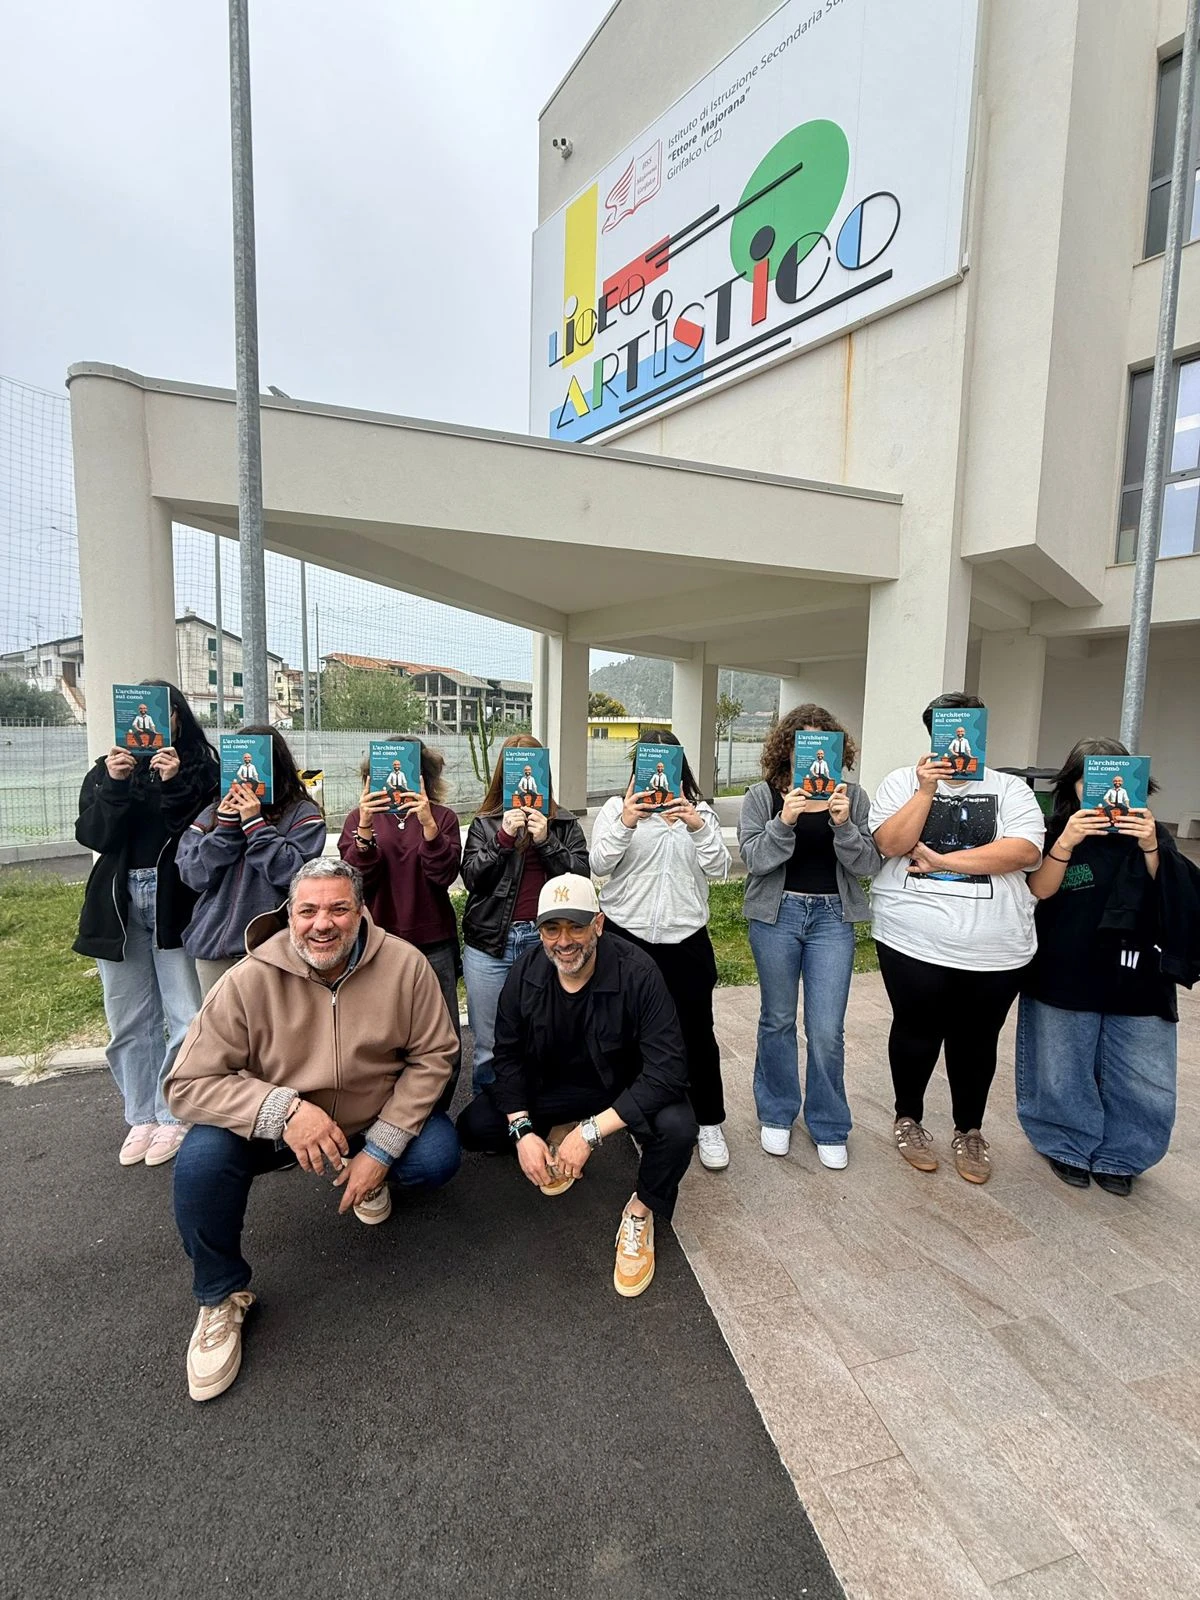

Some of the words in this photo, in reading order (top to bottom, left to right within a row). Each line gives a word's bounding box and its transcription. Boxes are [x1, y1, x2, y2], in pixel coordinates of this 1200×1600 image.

[668, 117, 698, 149] Istituto
[700, 105, 709, 121] di
[710, 66, 759, 111] Istruzione
[760, 10, 822, 70] Secondaria
[825, 0, 844, 13] Su
[667, 147, 701, 180] Girifalco
[704, 128, 723, 153] (CZ)
